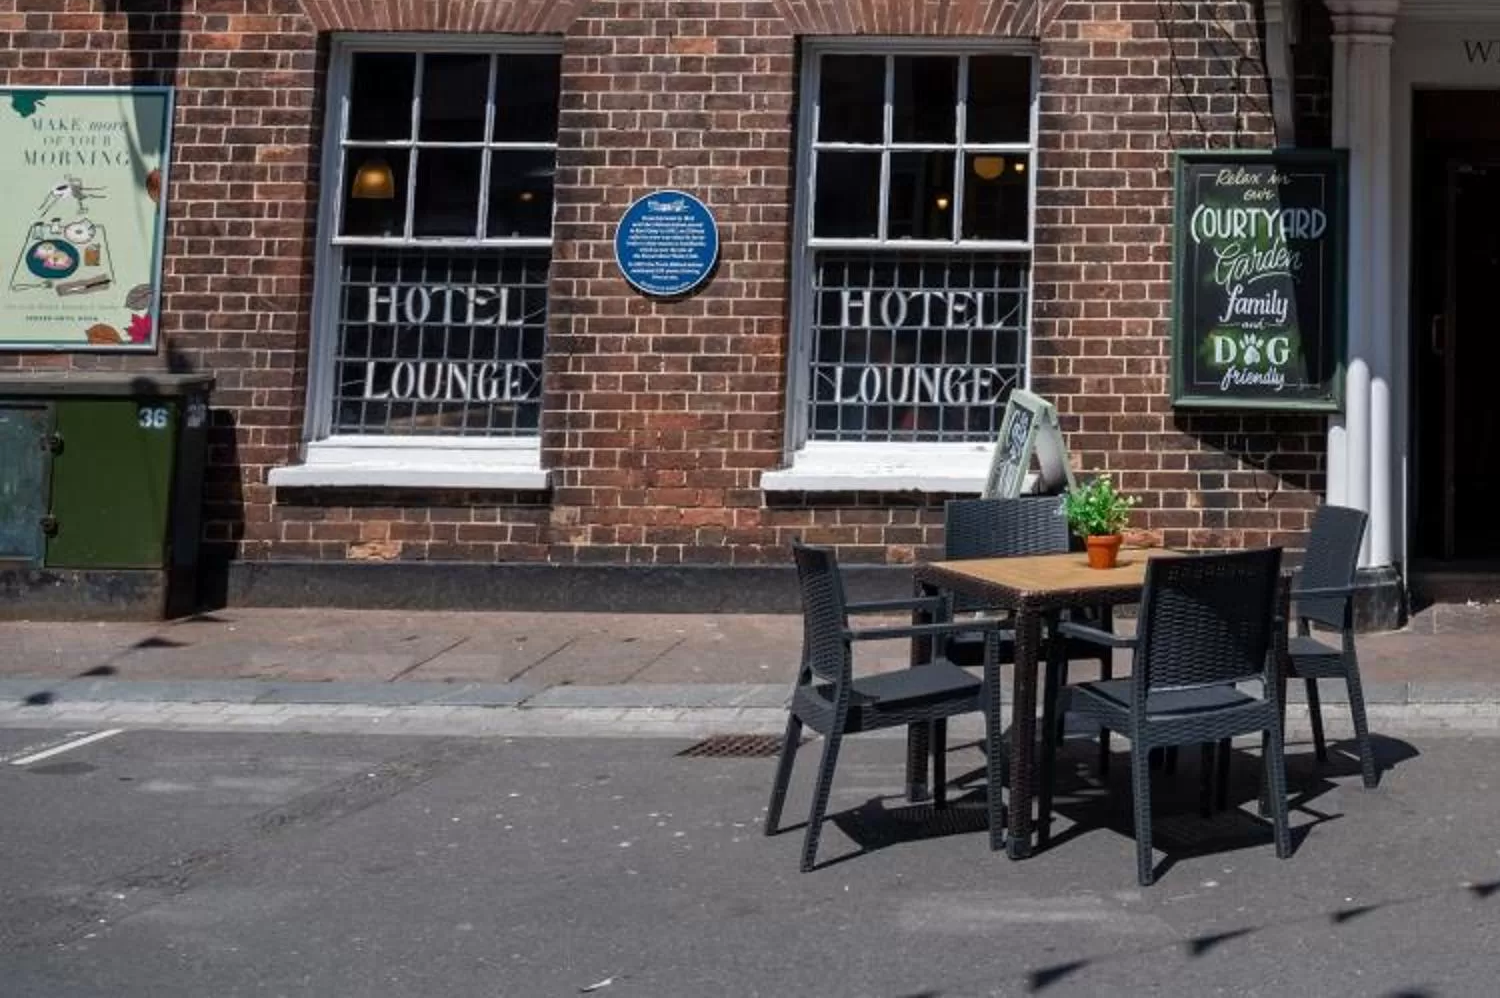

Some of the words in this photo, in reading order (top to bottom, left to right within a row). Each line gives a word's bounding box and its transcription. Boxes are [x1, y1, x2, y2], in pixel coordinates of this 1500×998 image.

[31, 118, 81, 131] MAKE
[89, 121, 127, 131] more
[23, 149, 130, 166] MORNING
[1216, 169, 1262, 186] Relax
[1267, 170, 1291, 186] in
[1243, 190, 1276, 201] our
[1190, 203, 1327, 243] COURTYARD
[1212, 238, 1302, 290] Garden
[367, 286, 525, 325] HOTEL
[842, 291, 1002, 328] HOTEL
[1218, 283, 1289, 323] family
[364, 361, 530, 401] LOUNGE
[835, 366, 1000, 404] LOUNGE
[1219, 364, 1285, 391] friendly
[139, 408, 168, 429] 36
